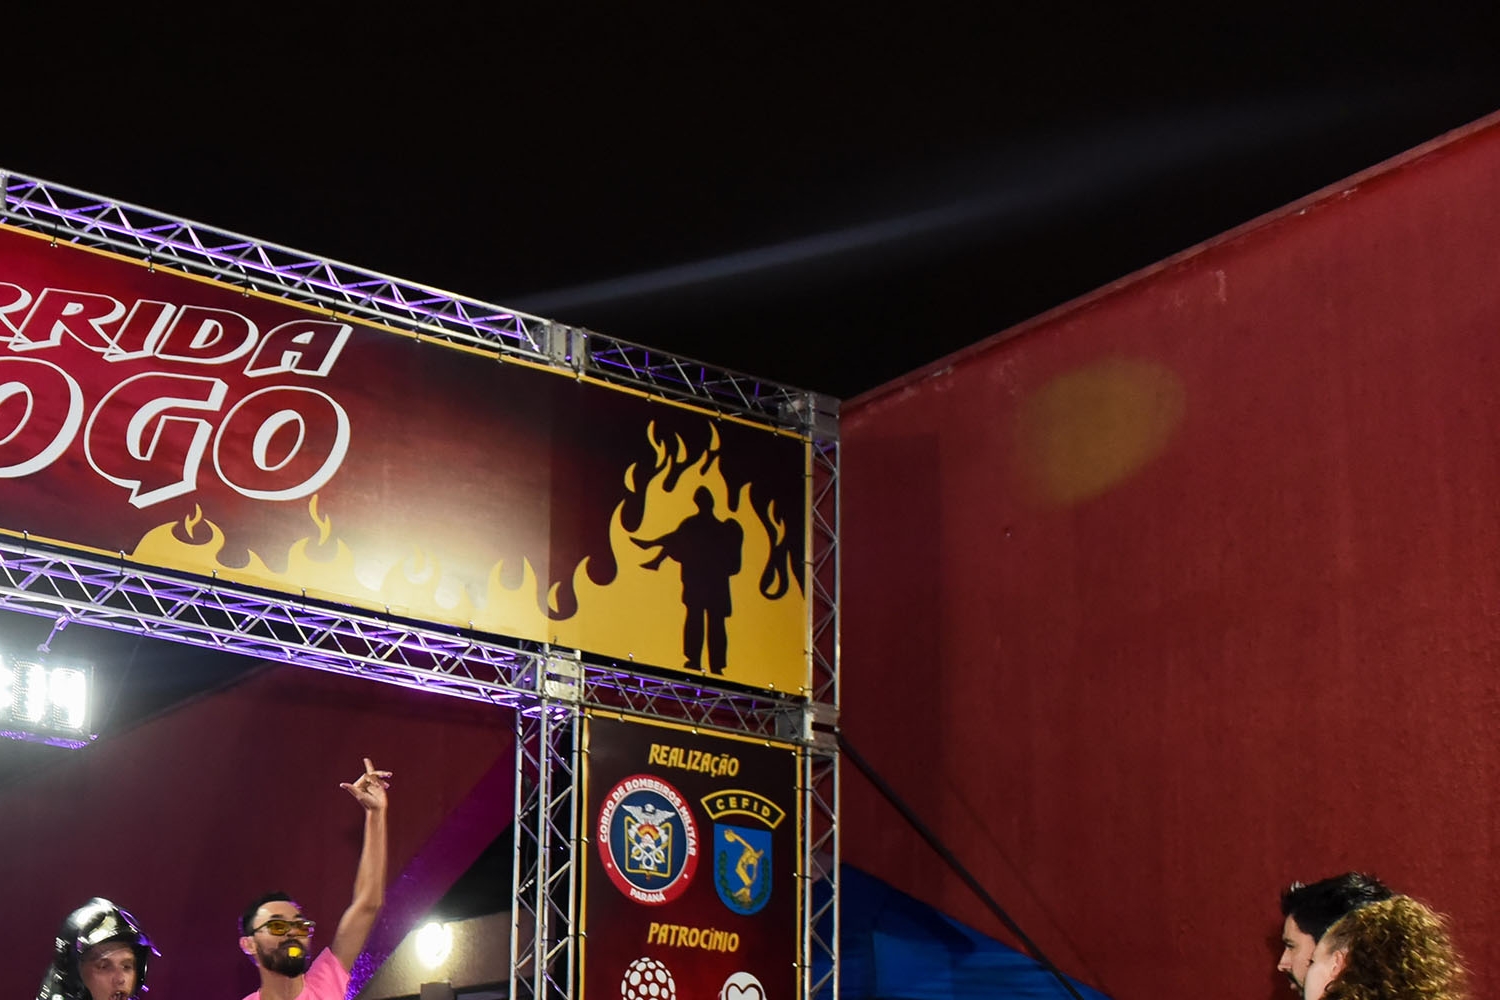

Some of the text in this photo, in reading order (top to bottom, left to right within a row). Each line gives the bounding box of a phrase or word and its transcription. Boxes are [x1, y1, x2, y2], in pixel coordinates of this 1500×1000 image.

[648, 743, 739, 777] REALIZAÇÃO
[599, 778, 697, 856] CORPO DE BOMBEIROS MILITAR
[715, 798, 771, 819] CEFID
[630, 889, 666, 903] PARANÁ
[647, 922, 740, 953] PATROCÍNIO
